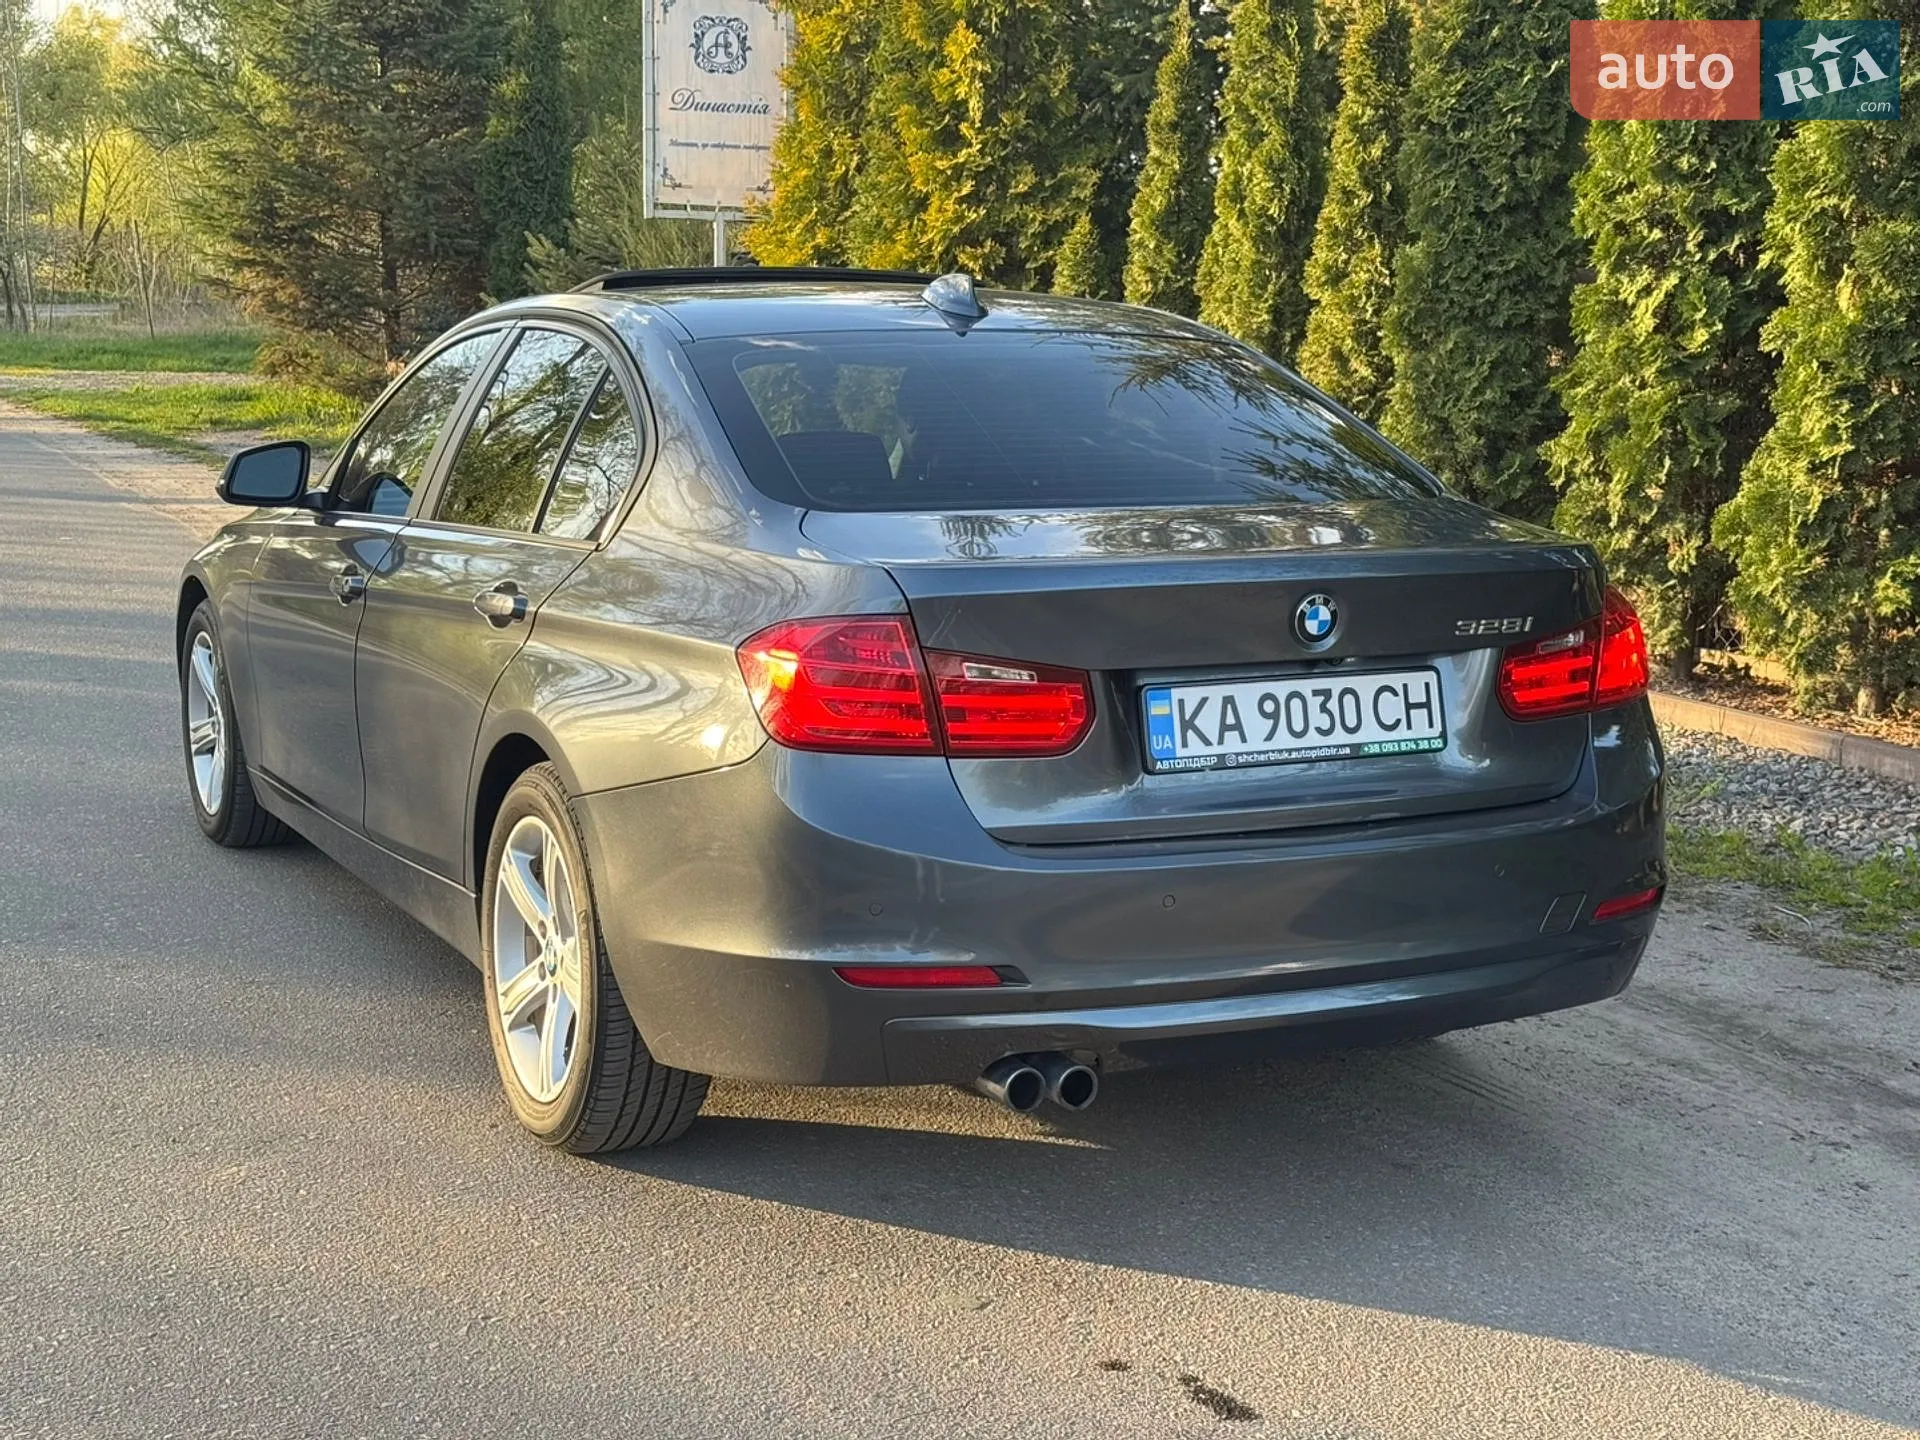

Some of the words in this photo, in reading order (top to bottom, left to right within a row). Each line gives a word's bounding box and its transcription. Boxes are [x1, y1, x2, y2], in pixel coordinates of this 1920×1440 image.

[668, 88, 771, 115] Династія
[1302, 595, 1337, 612] BMW
[1455, 616, 1534, 635] 328i
[1177, 695, 1248, 749] KA
[1257, 687, 1362, 742] 9030
[1373, 682, 1434, 732] CH
[1153, 735, 1173, 750] UA
[1363, 743, 1380, 754] +38
[1430, 738, 1443, 748] 00
[1155, 756, 1218, 770] АВТОПІДБІР
